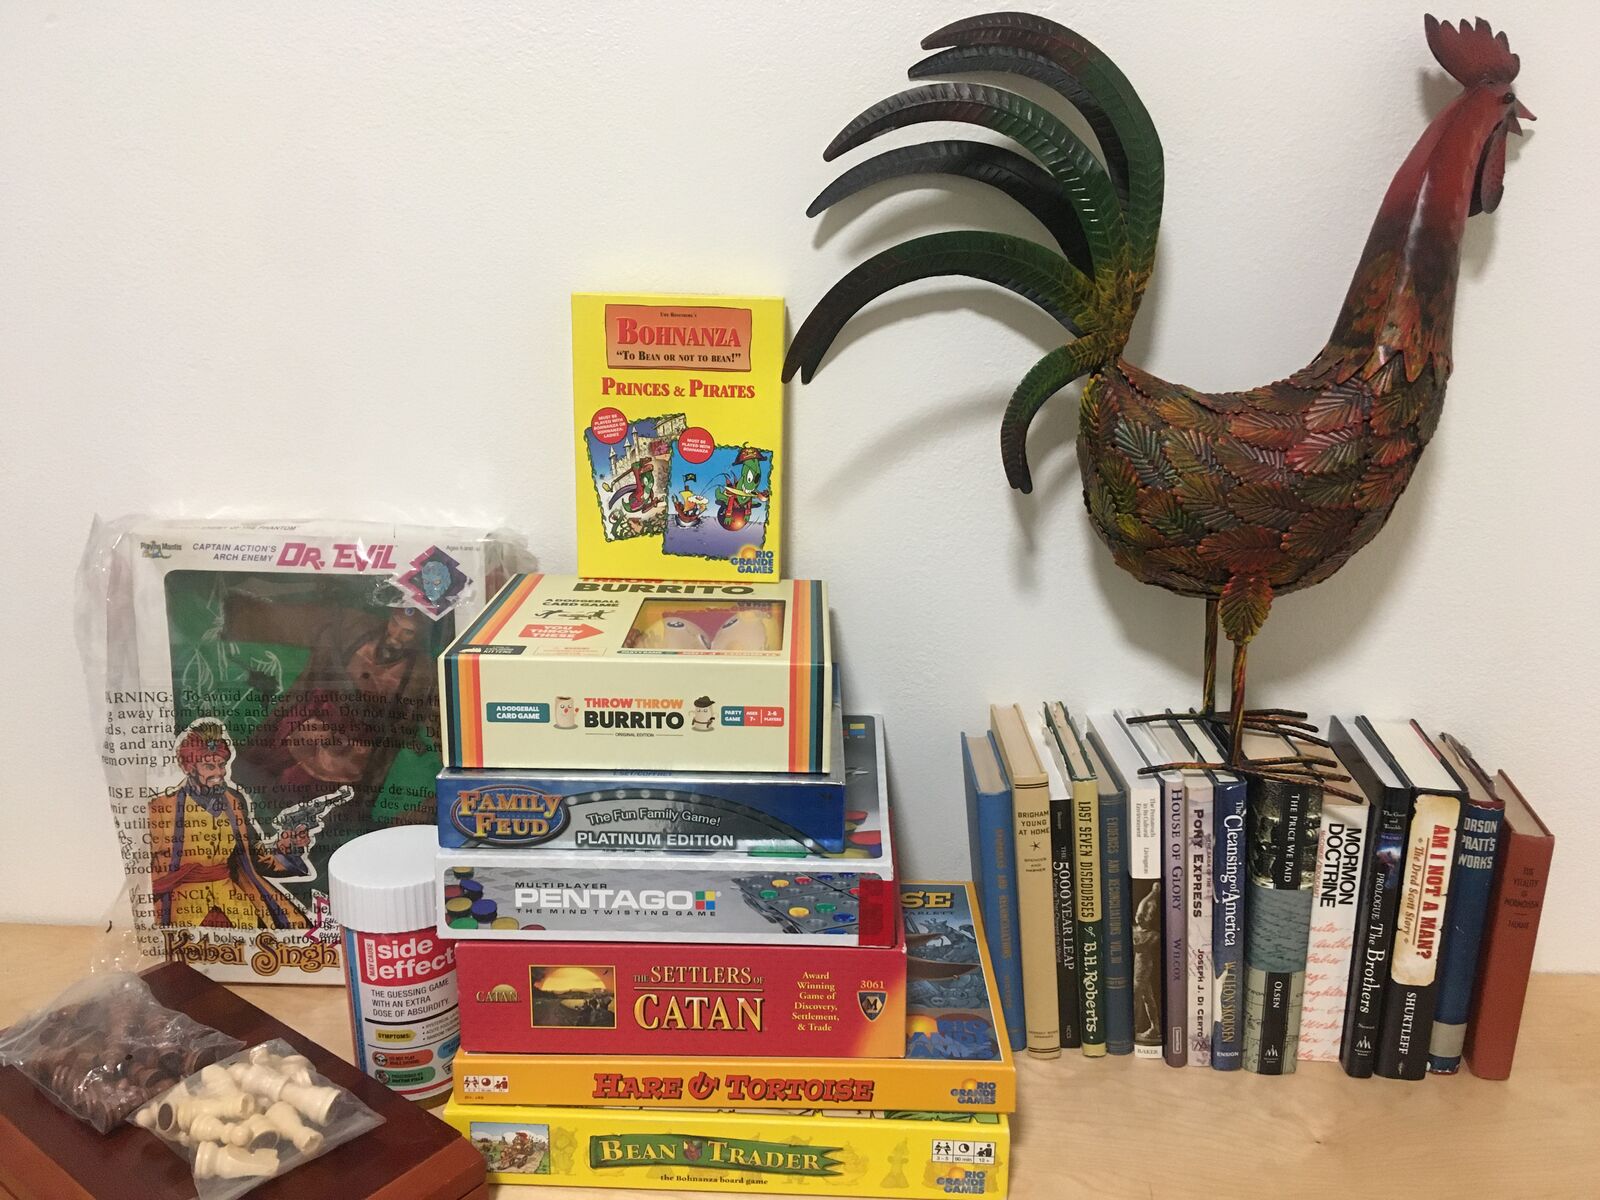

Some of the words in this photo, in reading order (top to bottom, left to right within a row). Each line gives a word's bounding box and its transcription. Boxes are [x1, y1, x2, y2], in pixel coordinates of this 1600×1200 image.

[616, 317, 742, 348] BOHNANZA
[638, 350, 661, 361] BEAN
[663, 353, 676, 362] OR
[678, 354, 695, 362] NOT
[697, 354, 708, 363] TO
[601, 377, 670, 397] PRINCES
[673, 386, 686, 398] &
[689, 379, 756, 399] PIRATES
[192, 542, 231, 551] CAPTAIN
[234, 544, 277, 553] ACTION'S
[755, 550, 774, 559] RIO
[213, 553, 239, 561] ARCH
[241, 554, 274, 562] ENEMY
[730, 557, 774, 566] GRANDE
[737, 565, 774, 574] GAMES
[573, 582, 754, 595] BURRITO
[207, 690, 241, 701] avoid
[584, 698, 634, 709] THROW
[634, 699, 684, 709] THROW
[118, 708, 156, 721] away
[197, 706, 241, 718] babies
[249, 706, 273, 717] and
[496, 712, 517, 720] CARD
[518, 712, 540, 720] GAME
[584, 710, 685, 730] BURRITO
[288, 721, 318, 732] This
[321, 720, 346, 734] bag
[119, 738, 146, 750] and
[151, 740, 175, 753] any
[280, 734, 342, 747] materials
[151, 804, 172, 813] sac
[457, 790, 563, 819] FAMILY
[1078, 801, 1091, 823] LAST
[1235, 800, 1244, 814] The
[1290, 793, 1300, 812] THE
[124, 818, 171, 829] utiliser
[586, 812, 611, 826] The
[613, 809, 637, 821] Fun
[639, 808, 679, 822] Family
[681, 810, 721, 827] Game!
[1017, 810, 1049, 818] BRIGHAM
[1021, 819, 1047, 827] YOUNG
[1171, 789, 1183, 839] HOUSE
[473, 812, 550, 838] FEUD
[1030, 827, 1050, 835] HOME
[1193, 809, 1205, 849] PONY
[1287, 815, 1298, 841] PRICE
[1463, 817, 1498, 833] ORSON
[576, 832, 661, 846] PLATINUM
[666, 834, 734, 847] EDITION
[1079, 827, 1093, 857] SEVEN
[1431, 824, 1450, 849] AM
[1171, 843, 1181, 861] OF
[1220, 814, 1244, 885] Cleansing
[1286, 844, 1296, 858] WE
[1413, 846, 1425, 863] The
[1430, 853, 1447, 861] I
[1107, 859, 1120, 874] AND
[1284, 861, 1294, 883] PAID
[1320, 823, 1345, 908] DOCTRINE
[1337, 828, 1362, 906] MORMON
[1410, 863, 1422, 887] Dred
[1053, 861, 1072, 899] 5000
[1171, 866, 1183, 911] GLORY
[1193, 854, 1204, 918] EXPRESS
[1425, 865, 1445, 897] NOT
[514, 888, 694, 910] PENTAGO
[1080, 862, 1094, 919] DISCOURSES
[1407, 887, 1418, 912] Scott
[176, 904, 203, 915] esta
[1422, 901, 1439, 912] A
[1062, 900, 1073, 935] YEAR
[1222, 890, 1241, 947] America
[1403, 912, 1415, 936] Story
[1084, 926, 1096, 937] of
[1368, 923, 1384, 945] The
[1416, 916, 1437, 960] MAN?
[251, 932, 341, 977] Singh
[366, 943, 375, 963] CAUSE
[377, 938, 433, 960] side
[1063, 936, 1075, 970] LEAP
[1173, 938, 1181, 982] WILCOX
[1197, 949, 1205, 983] JOSEPH
[633, 975, 649, 983] THE
[651, 965, 752, 985] SETTLERS
[753, 976, 764, 984] OF
[802, 971, 830, 980] Award
[860, 980, 885, 989] 3061
[1359, 947, 1385, 1014] Brothers
[371, 989, 385, 998] THE
[387, 986, 427, 999] GUESSING
[429, 978, 449, 992] GAME
[797, 981, 835, 992] Winning
[799, 992, 824, 1000] Game
[826, 991, 836, 1000] of
[1272, 981, 1283, 1009] OLSEN
[372, 999, 391, 1008] WITH
[392, 1000, 403, 1008] AN
[405, 995, 431, 1007] EXTRA
[476, 991, 519, 1003] CATAN
[794, 1001, 838, 1012] Discovery,
[1197, 996, 1204, 1006] DI
[373, 1008, 393, 1017] DOSE
[407, 998, 449, 1016] ABSURDITY
[633, 993, 765, 1032] CATAN
[792, 1012, 840, 1021] Settlement,
[797, 1023, 806, 1031] &
[808, 1023, 832, 1031] Trade
[1197, 1008, 1205, 1038] CERTO
[1399, 991, 1417, 1055] SHURTLEFF
[591, 1073, 684, 1100] HARE
[687, 1071, 720, 1100] &
[724, 1074, 875, 1103] TORTOISE
[950, 1088, 996, 1097] GRANDE
[976, 1081, 997, 1090] RIO
[957, 1096, 996, 1105] GAMES
[599, 1139, 677, 1162] BEAN
[707, 1140, 821, 1171] TRADER
[676, 1174, 718, 1183] Bohnanza
[719, 1176, 744, 1184] board
[745, 1178, 768, 1186] game
[936, 1177, 985, 1187] GRANDE
[964, 1170, 986, 1179] RIO
[943, 1185, 985, 1195] GAMES
